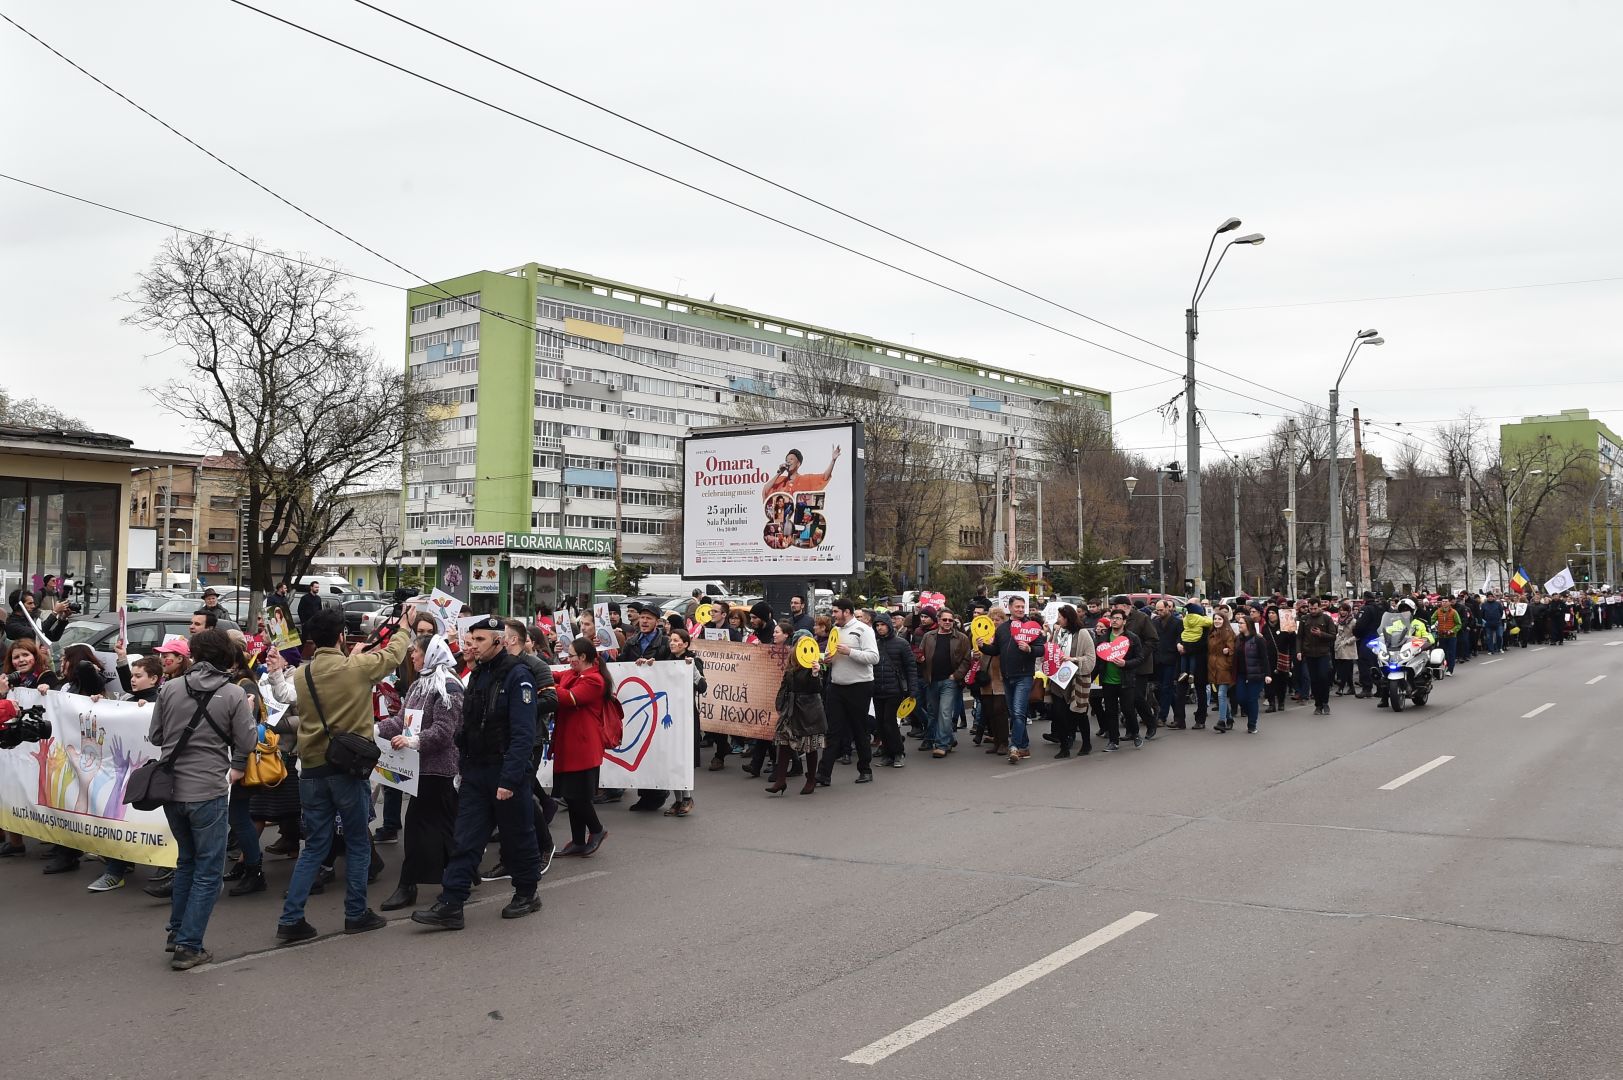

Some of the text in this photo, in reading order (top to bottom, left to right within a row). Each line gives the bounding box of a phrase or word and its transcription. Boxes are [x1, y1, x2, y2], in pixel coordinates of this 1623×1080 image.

[706, 456, 753, 471] Omara
[695, 468, 769, 487] Portuondo
[702, 488, 755, 498] celebrating music
[707, 504, 748, 517] 25 aprilie
[707, 517, 748, 526] Sala Palatului
[420, 536, 453, 546] Lycamobile
[455, 535, 504, 546] FLORARIE
[506, 535, 611, 553] FLORARIA NARCISA
[703, 650, 718, 658] COPII
[713, 683, 748, 703] GRIJĂ
[720, 705, 771, 726] NEVOIE!
[50, 816, 57, 829] ȘI
[93, 826, 122, 841] DEPIND
[126, 831, 137, 843] DE
[141, 832, 168, 847] TINE.
